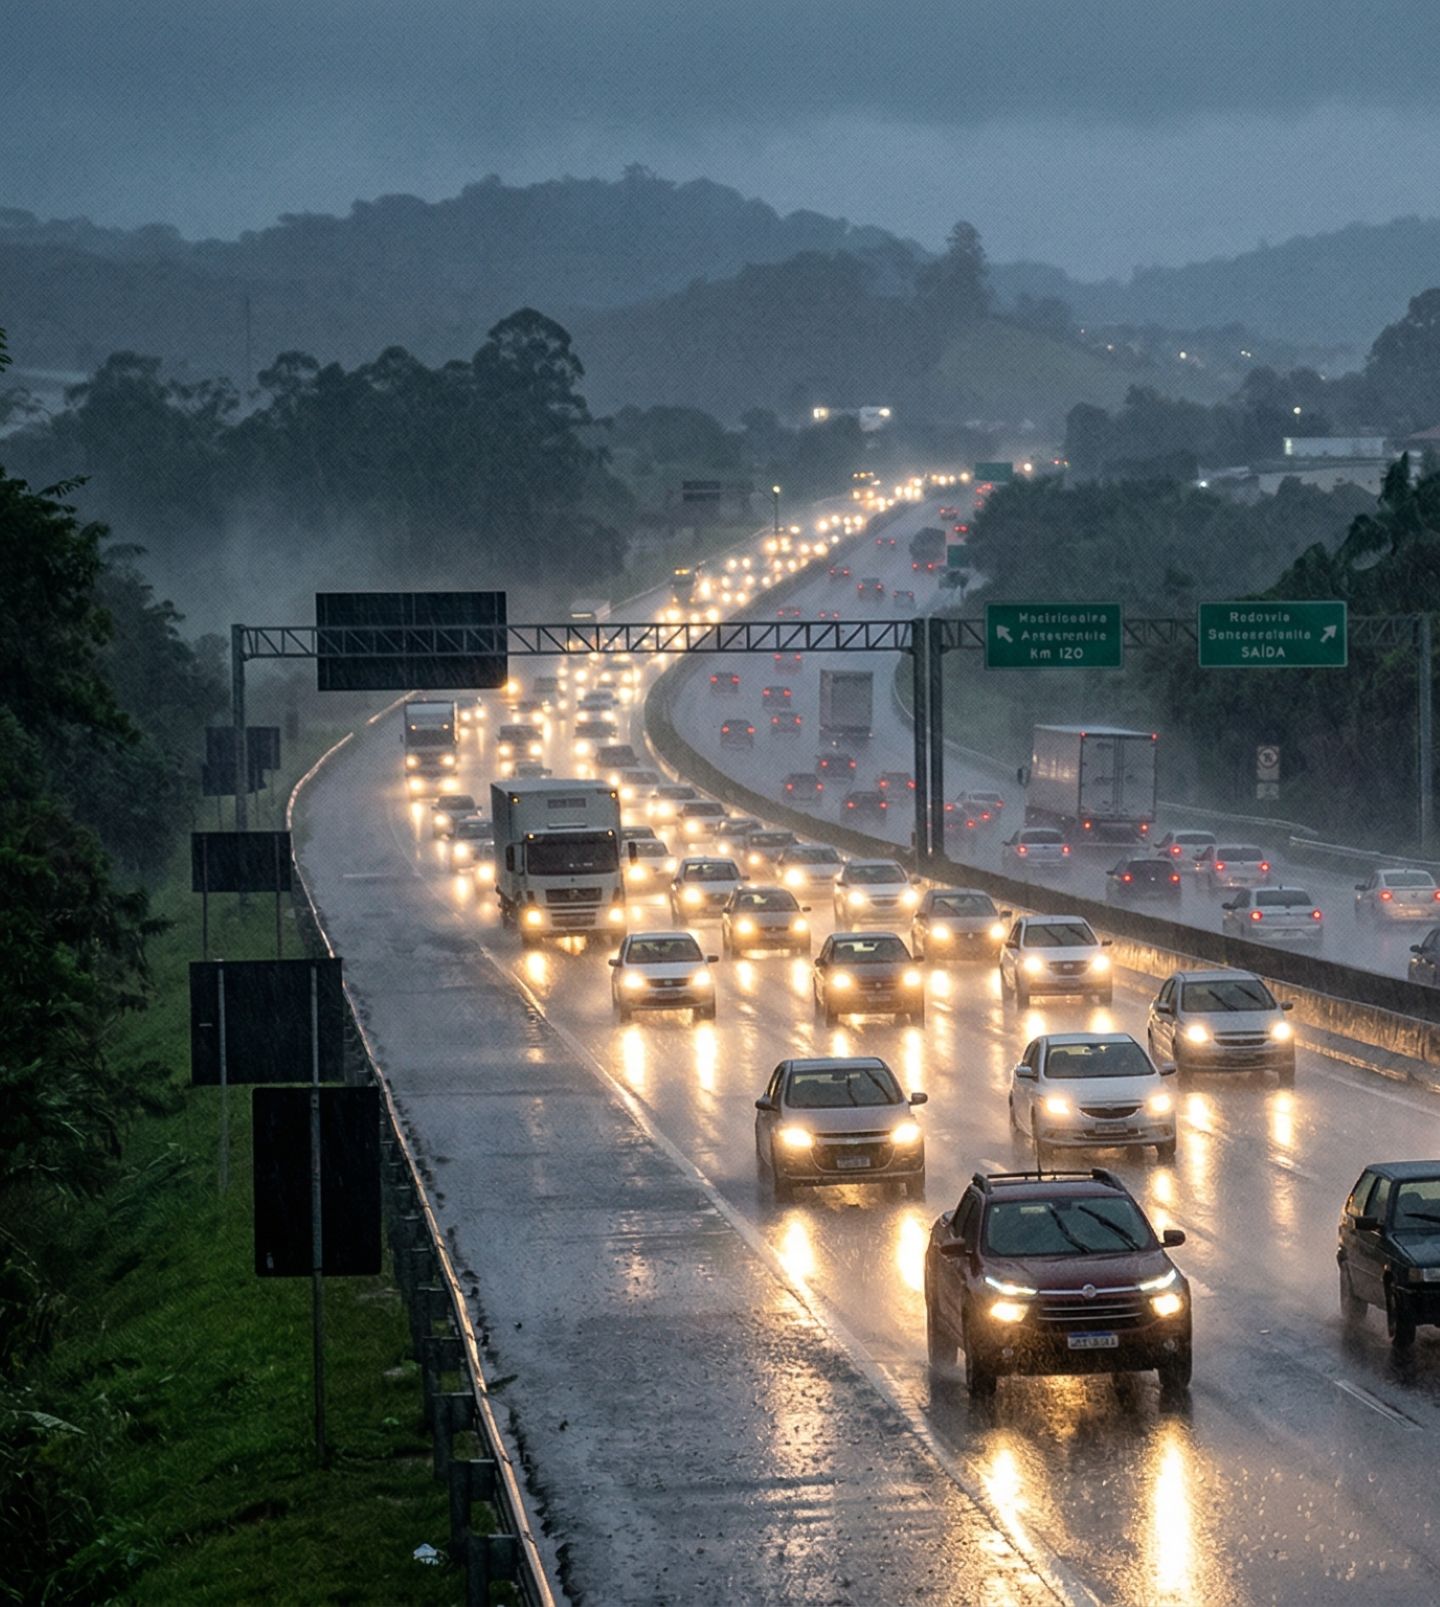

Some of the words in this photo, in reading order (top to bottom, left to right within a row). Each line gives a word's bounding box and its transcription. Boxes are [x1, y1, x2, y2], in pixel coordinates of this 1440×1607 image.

[1030, 647, 1052, 659] Km
[1059, 647, 1084, 659] 120
[1241, 643, 1286, 658] SAÍDA
